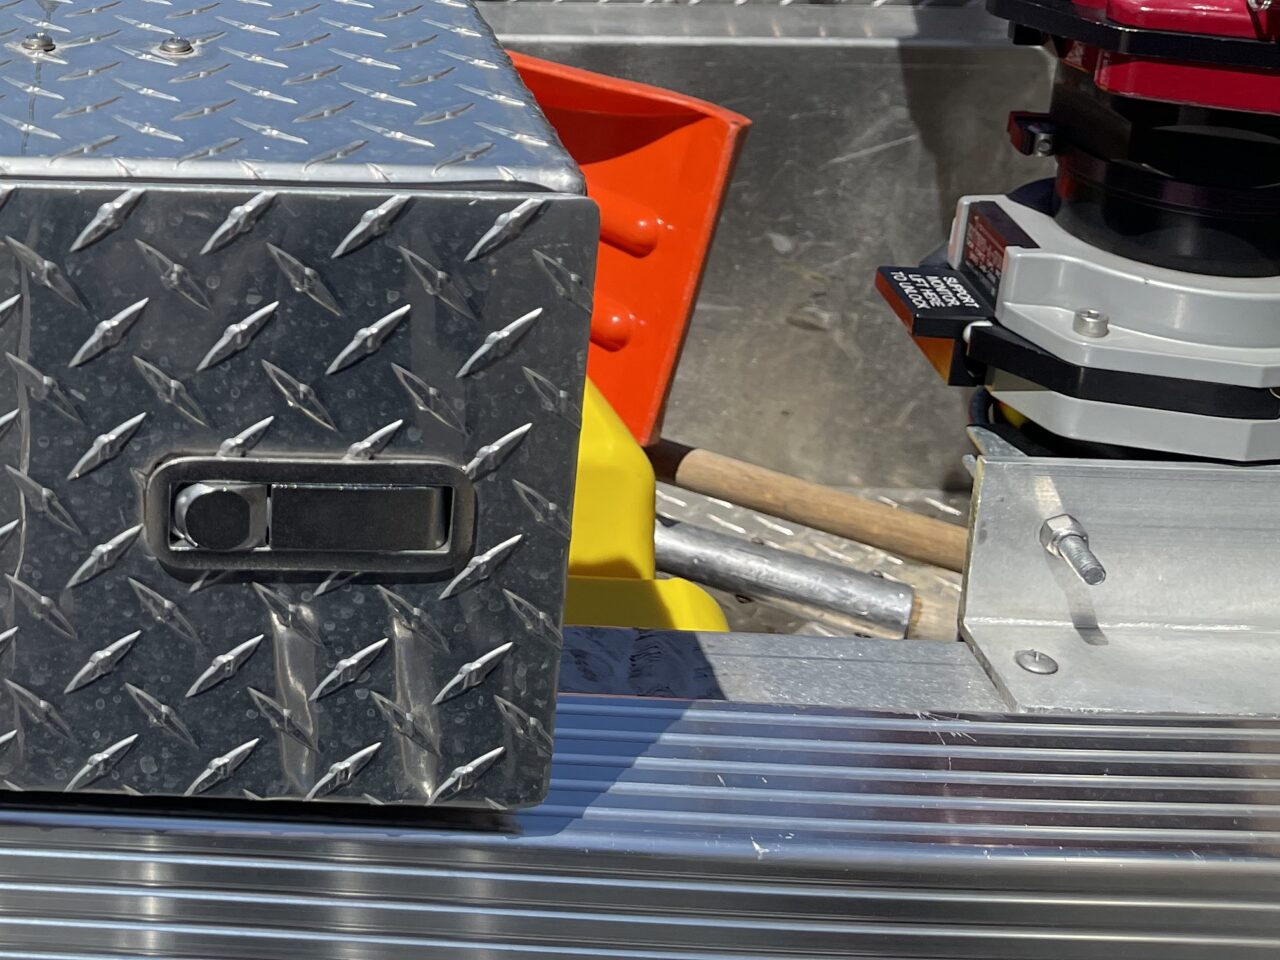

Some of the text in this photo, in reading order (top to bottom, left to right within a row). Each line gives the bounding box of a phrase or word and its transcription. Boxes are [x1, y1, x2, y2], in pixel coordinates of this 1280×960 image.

[890, 271, 931, 309] TO UNLOCK
[908, 274, 946, 307] LIFT HERE
[926, 275, 960, 307] MONITOR
[943, 276, 980, 308] SUPPORT
